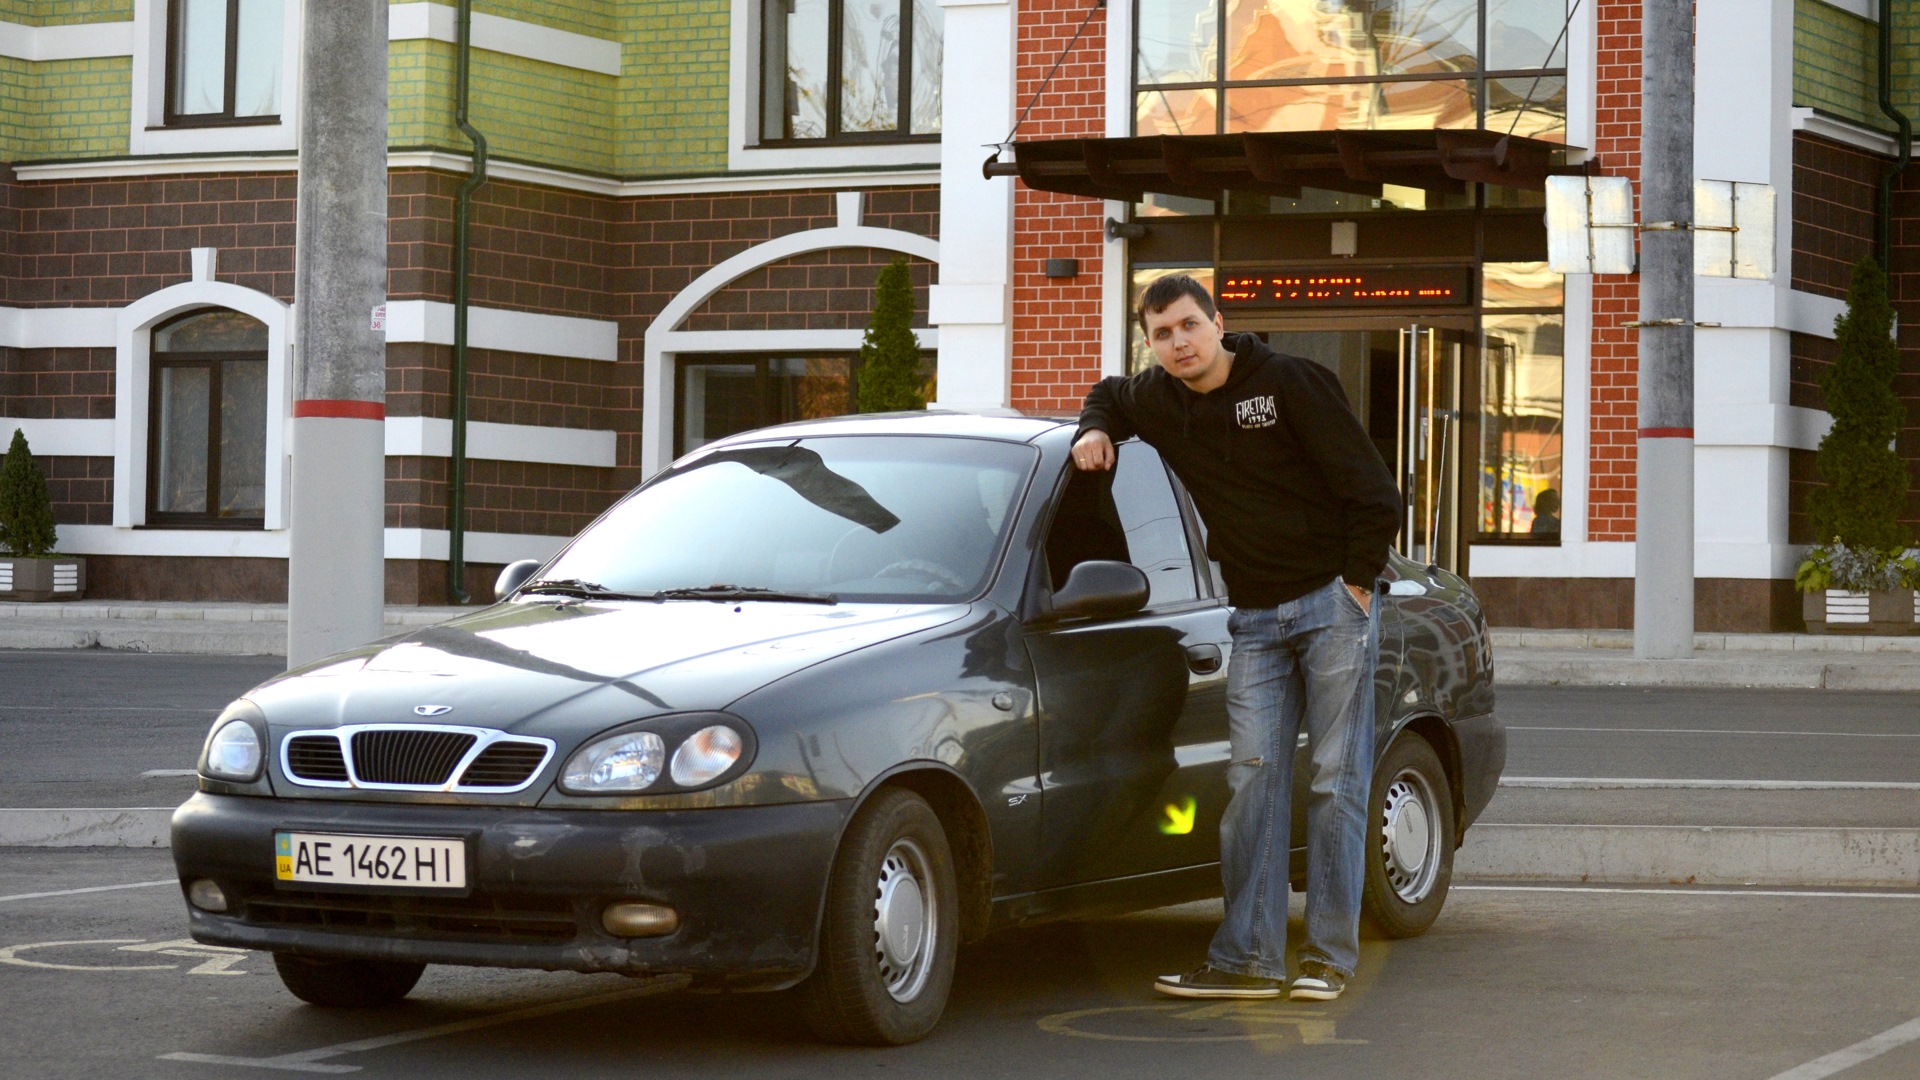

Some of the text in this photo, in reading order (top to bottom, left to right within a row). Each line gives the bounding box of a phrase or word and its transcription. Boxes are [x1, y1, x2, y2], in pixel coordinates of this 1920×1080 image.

[1008, 794, 1027, 807] SX
[279, 862, 292, 874] UA
[296, 841, 451, 883] AE 1462 HI
